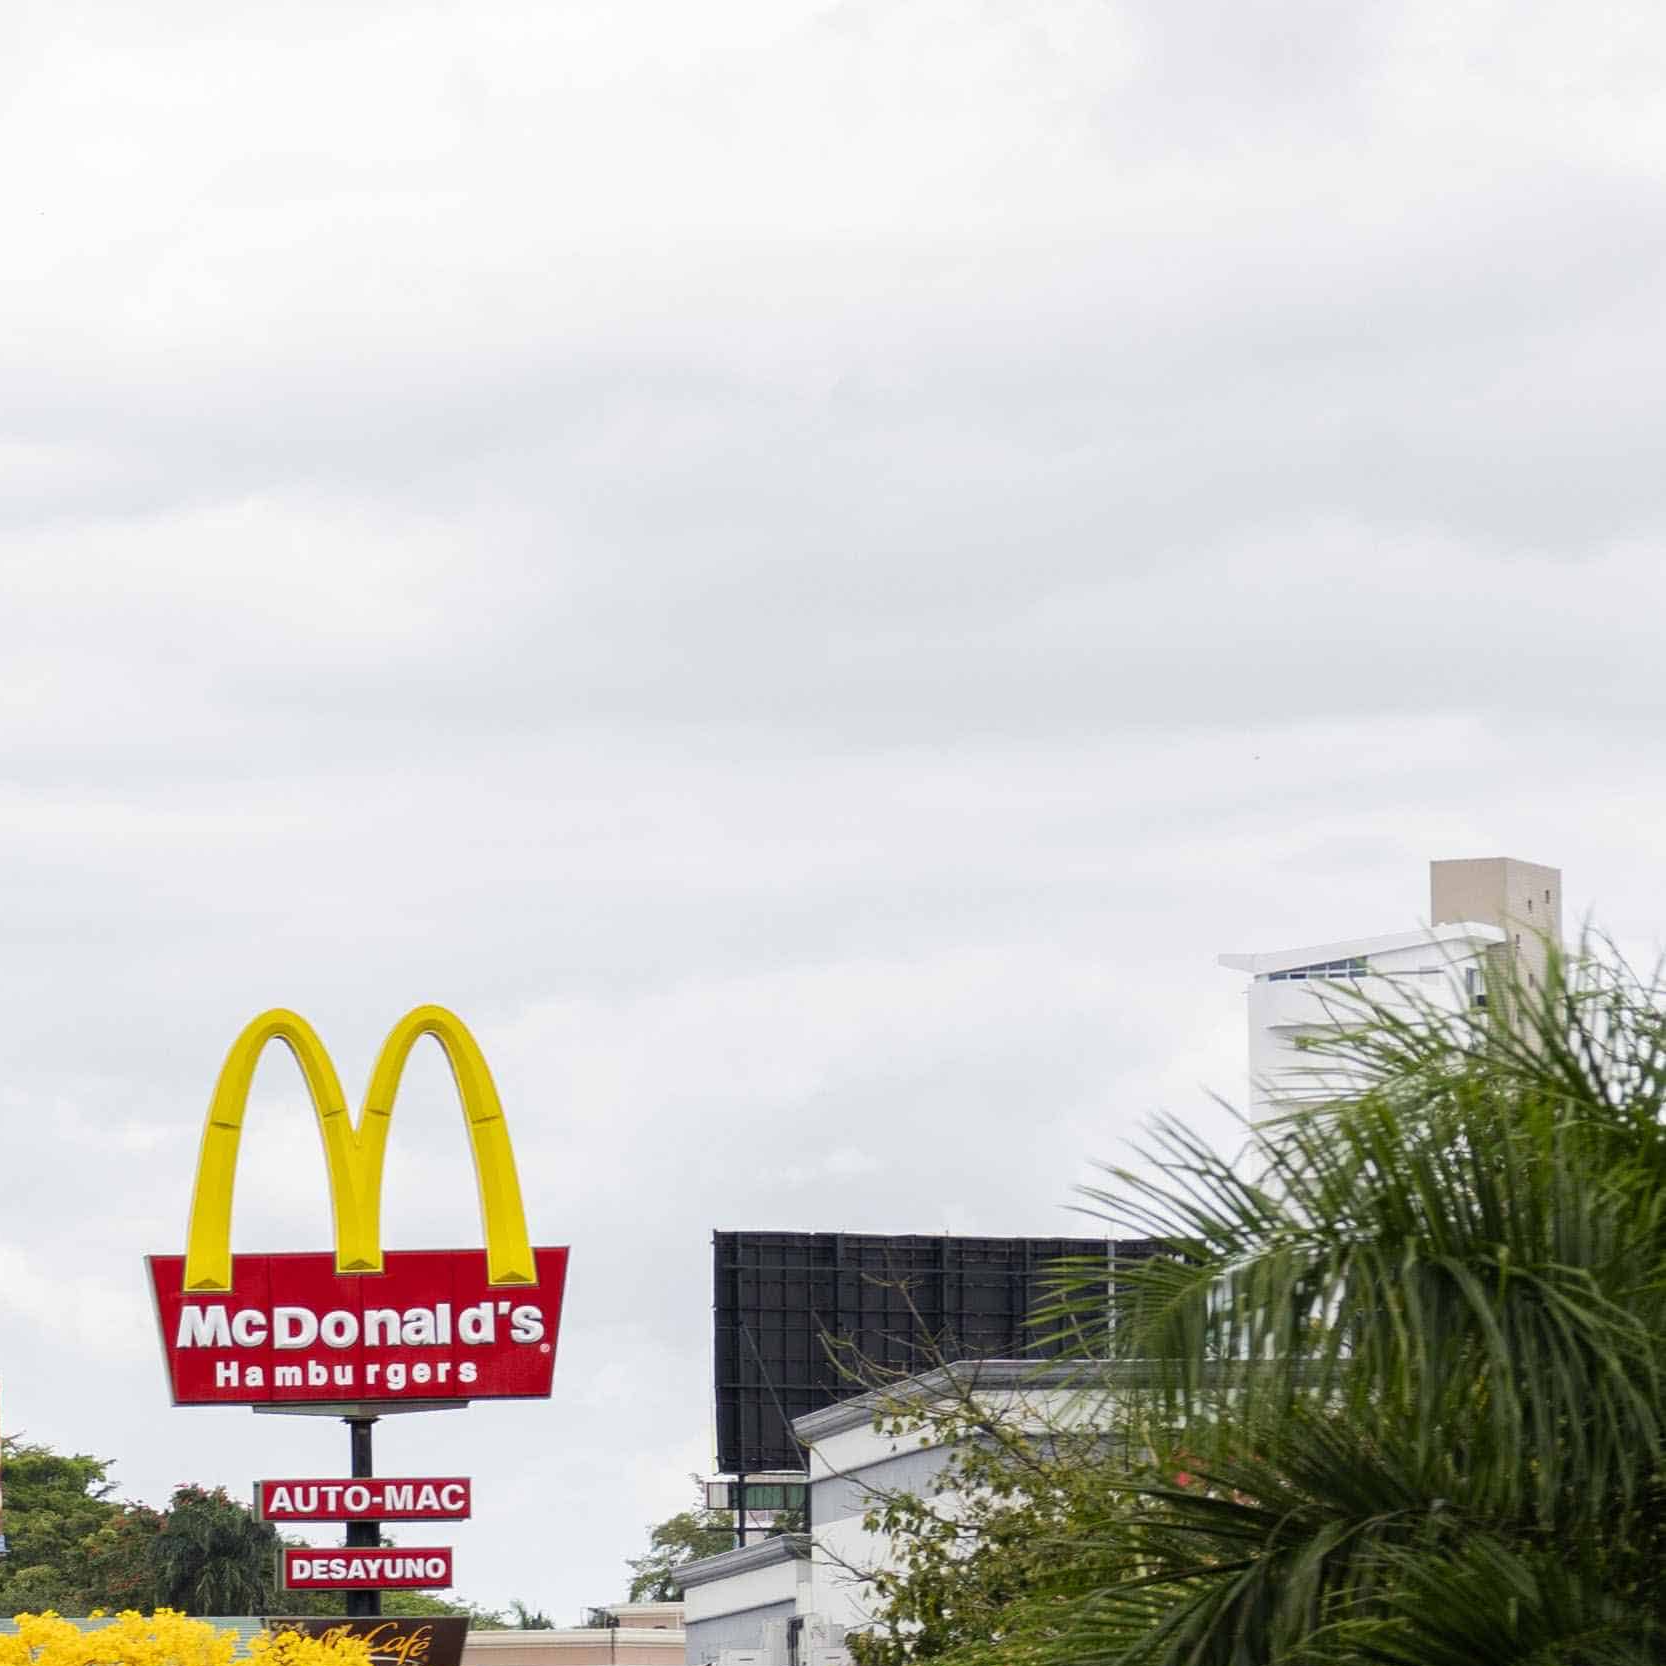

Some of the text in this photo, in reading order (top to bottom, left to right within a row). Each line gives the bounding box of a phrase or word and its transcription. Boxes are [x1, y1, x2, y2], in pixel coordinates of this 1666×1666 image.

[176, 1301, 546, 1349] McDonald's
[214, 1360, 478, 1389] Hamburgers
[269, 1484, 465, 1513] AUTO-MAC
[291, 1557, 446, 1580] DESAYUNO
